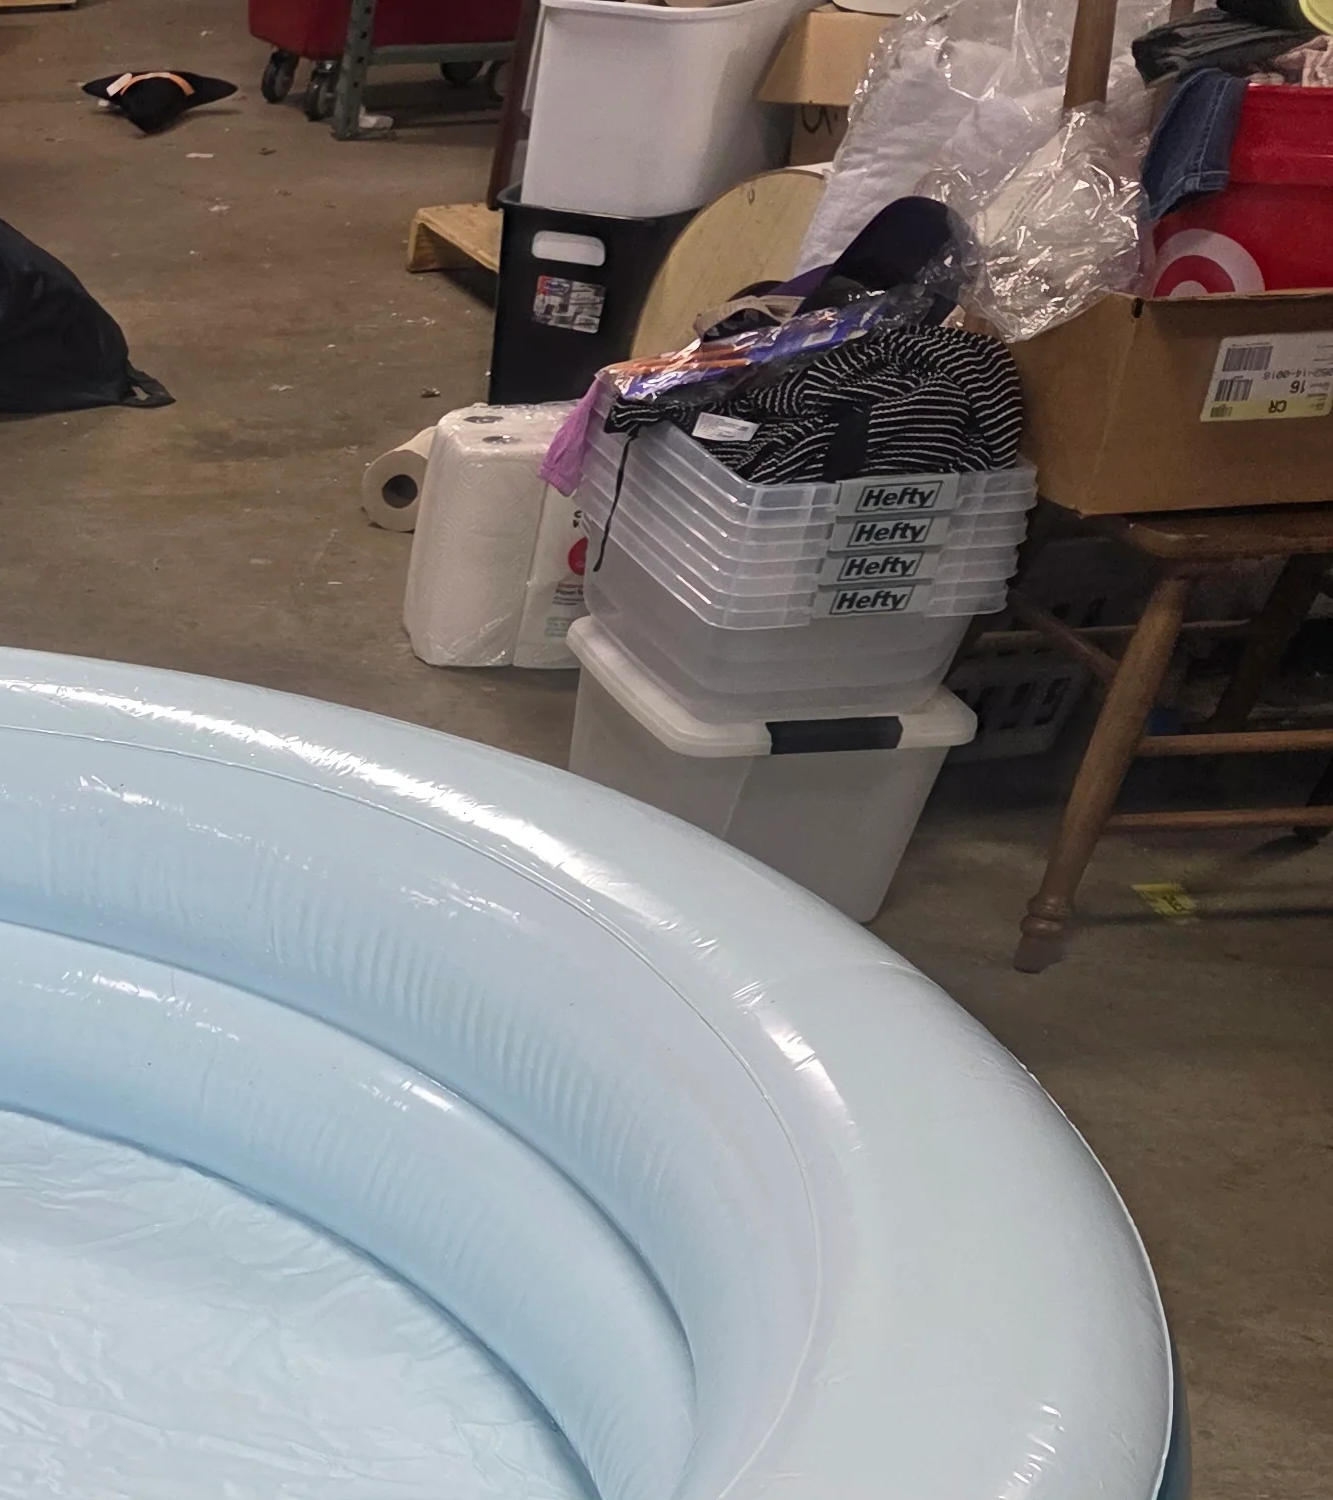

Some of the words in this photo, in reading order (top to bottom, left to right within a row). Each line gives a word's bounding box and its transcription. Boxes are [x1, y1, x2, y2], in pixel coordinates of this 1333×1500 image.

[1289, 379, 1305, 393] 16
[1268, 400, 1286, 412] CR
[862, 487, 935, 508] Hefty
[854, 522, 927, 542] Hefty
[844, 556, 917, 576] Hefty
[835, 590, 908, 610] Hefty
